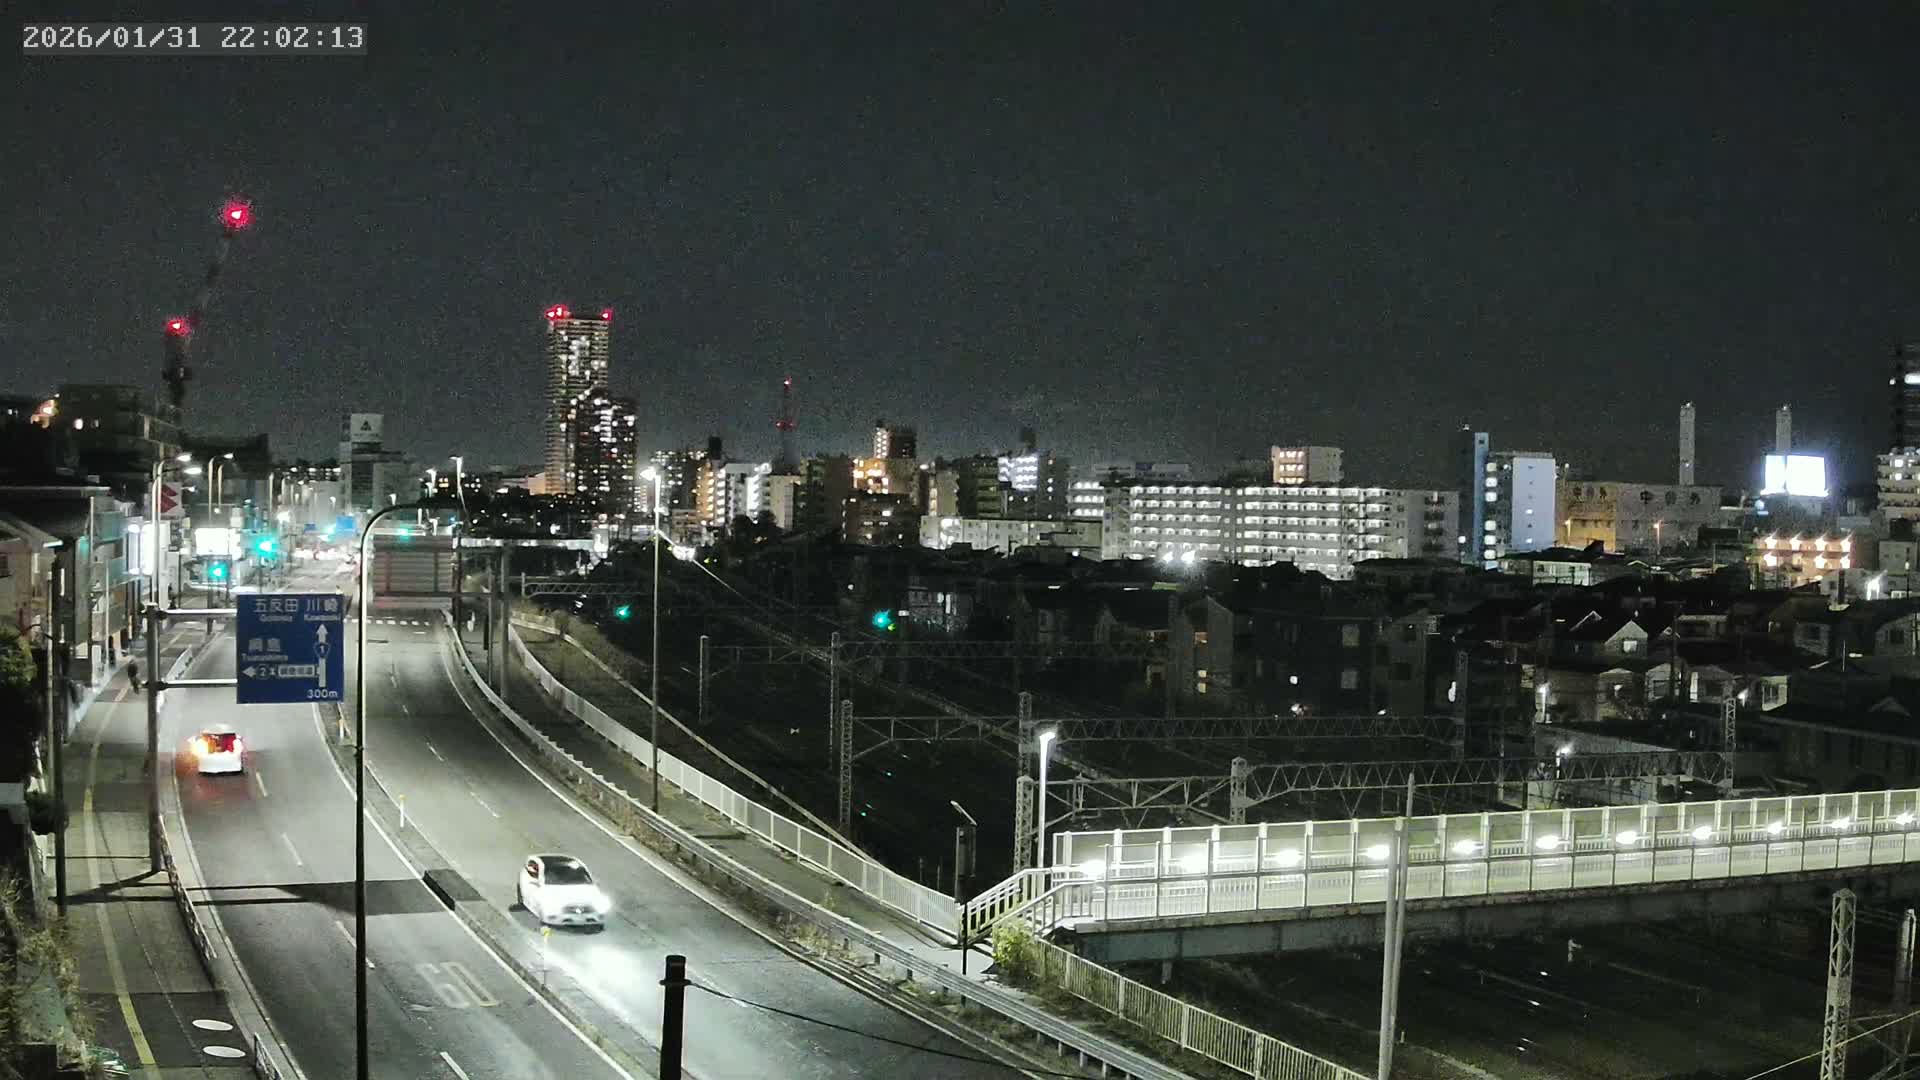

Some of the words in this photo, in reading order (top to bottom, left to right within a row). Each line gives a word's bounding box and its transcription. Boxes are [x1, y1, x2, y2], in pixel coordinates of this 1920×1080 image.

[254, 598, 298, 612] 五反田
[307, 689, 338, 698] 300m
